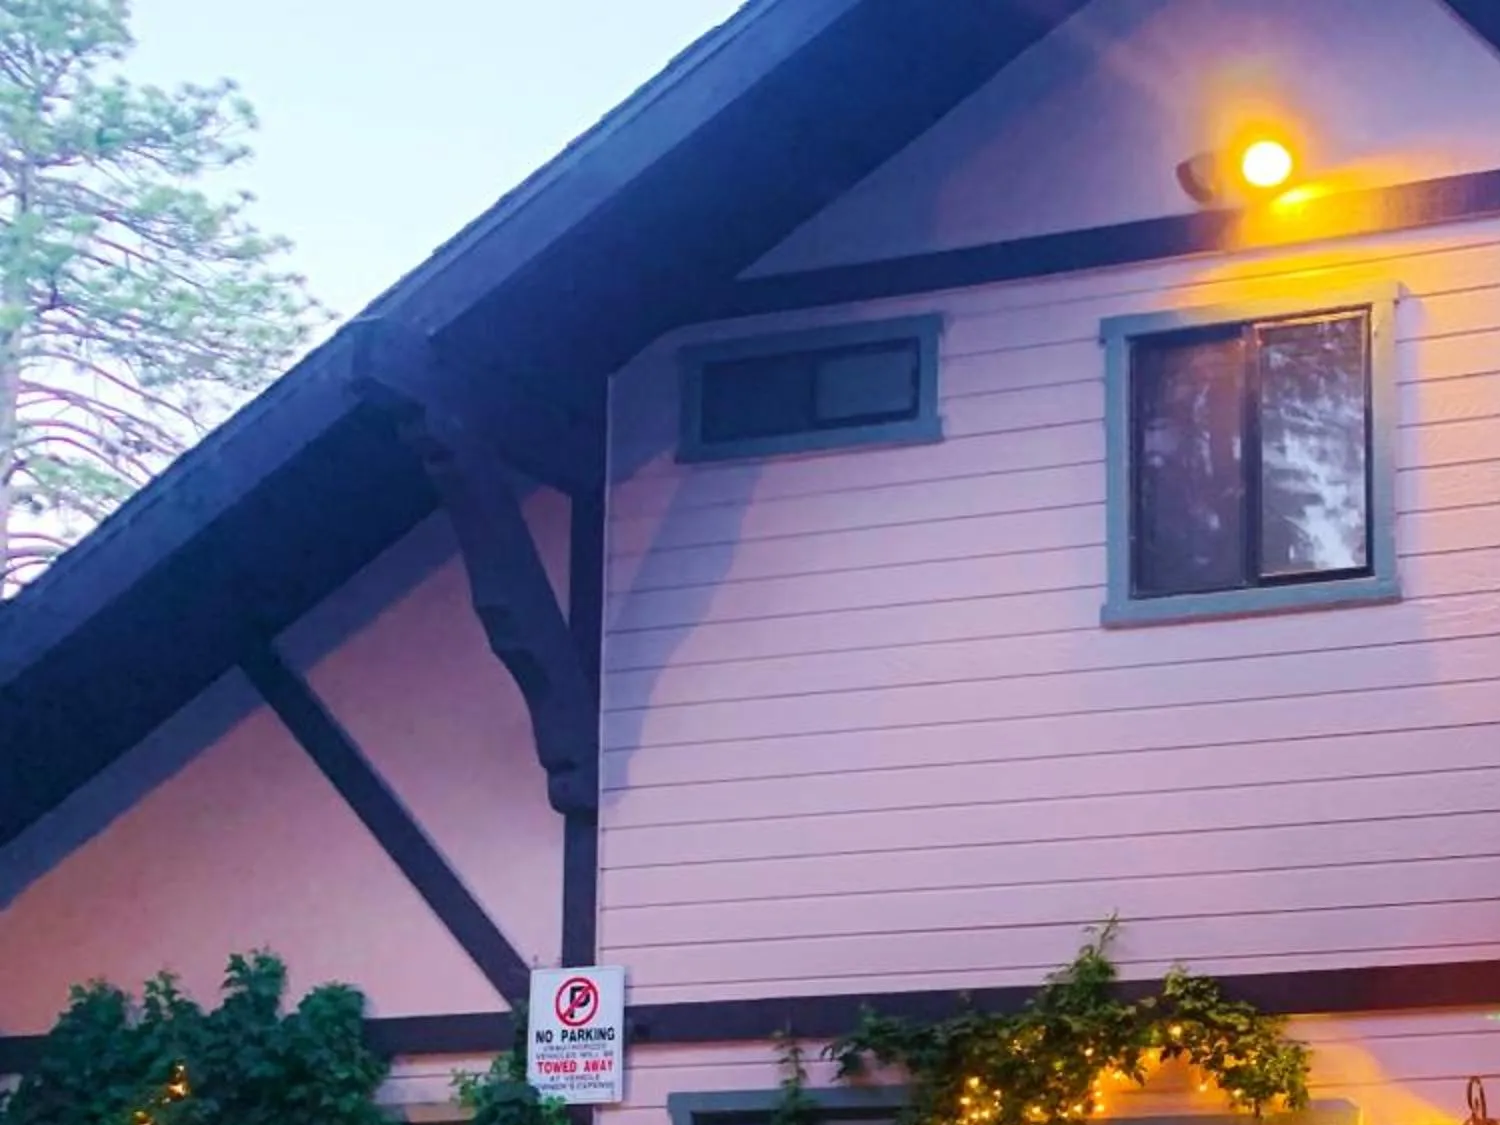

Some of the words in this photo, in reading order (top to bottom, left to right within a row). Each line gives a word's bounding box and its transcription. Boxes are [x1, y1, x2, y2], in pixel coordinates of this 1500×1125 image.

[535, 1029, 553, 1044] NO
[561, 1027, 615, 1043] PARKING
[537, 1060, 577, 1074] TOWED
[583, 1059, 613, 1073] AWAY
